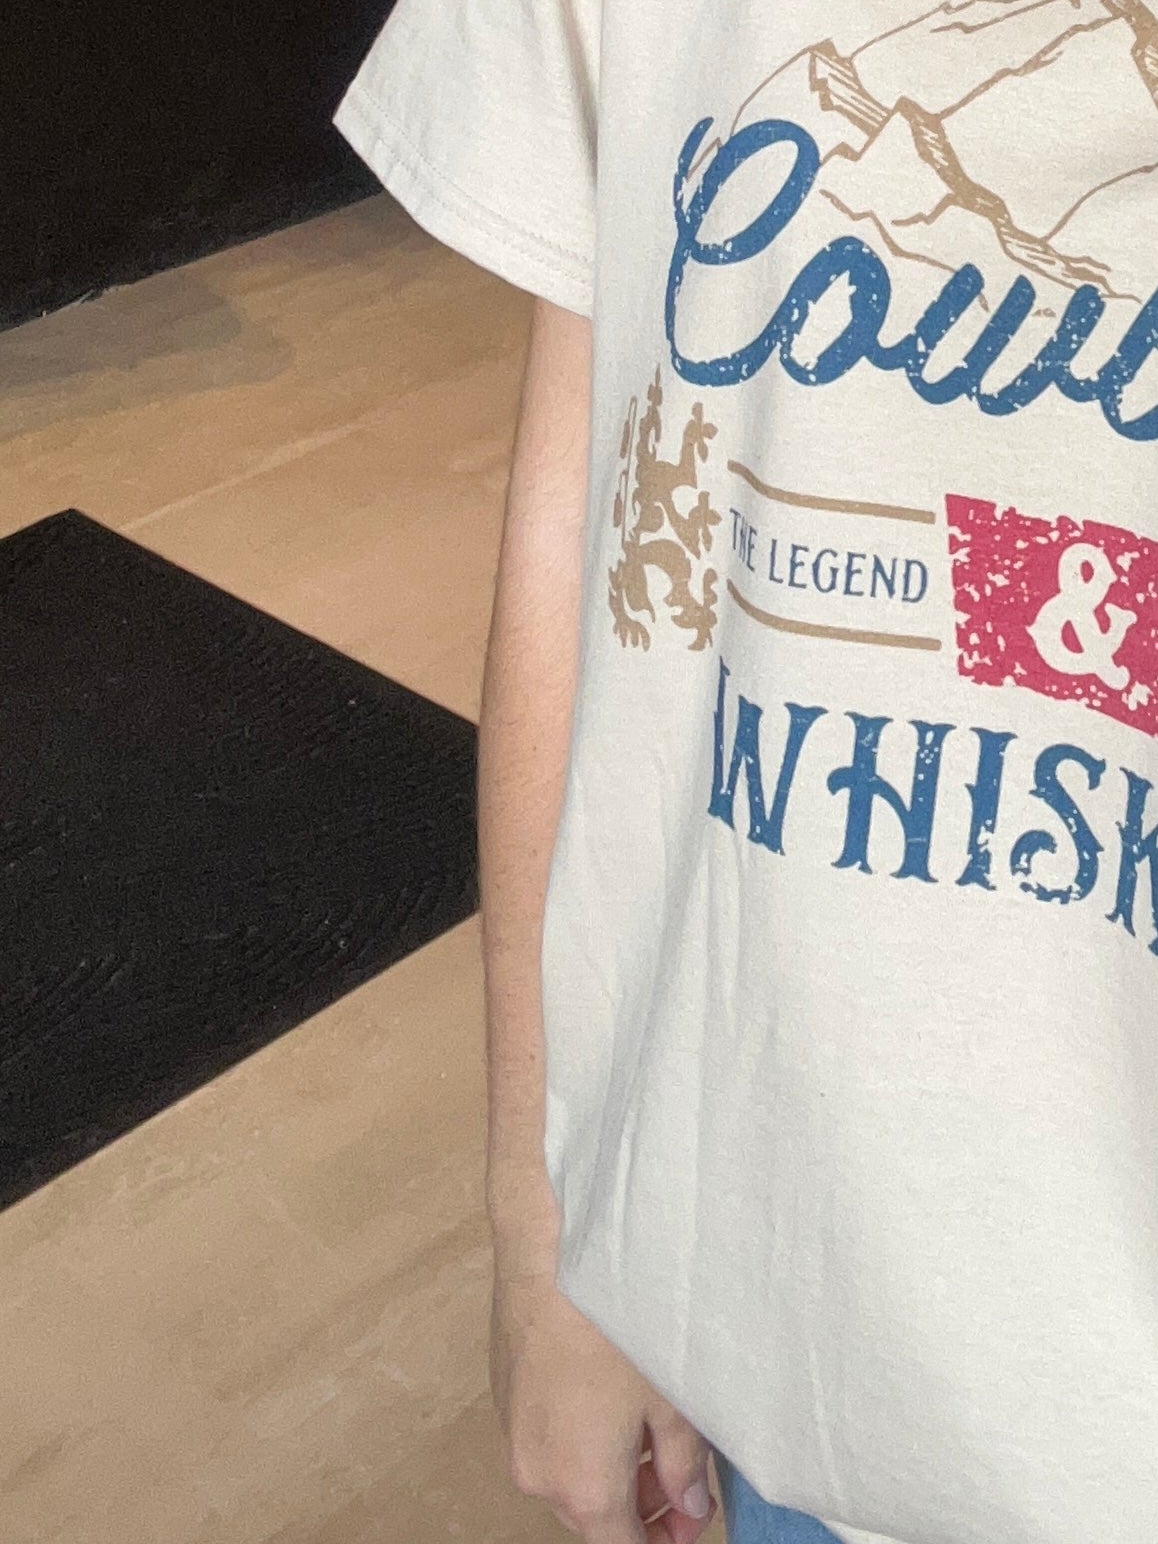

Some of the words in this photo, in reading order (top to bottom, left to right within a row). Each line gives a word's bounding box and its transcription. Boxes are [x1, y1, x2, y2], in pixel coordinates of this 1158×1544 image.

[730, 508, 758, 573] THE
[769, 538, 929, 604] LEGEND
[1028, 542, 1138, 691] &
